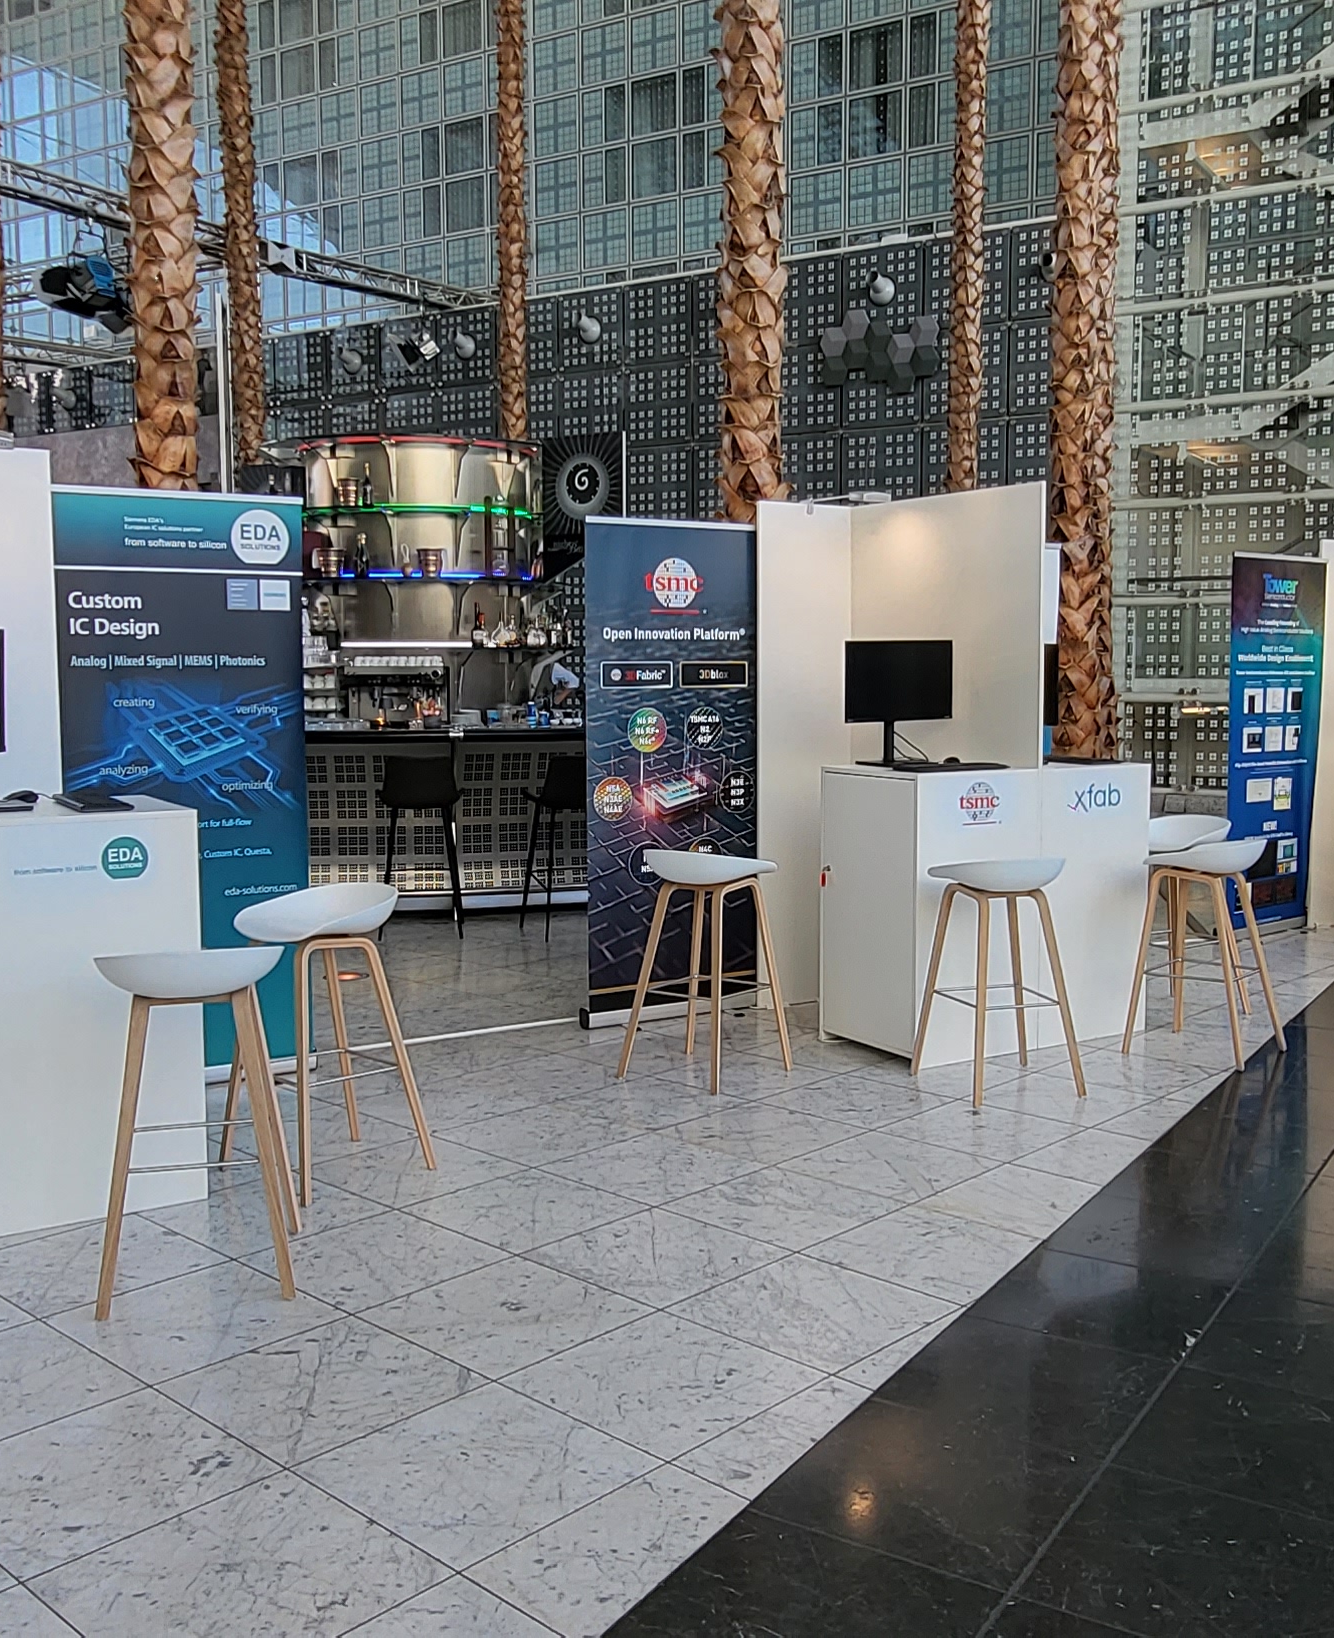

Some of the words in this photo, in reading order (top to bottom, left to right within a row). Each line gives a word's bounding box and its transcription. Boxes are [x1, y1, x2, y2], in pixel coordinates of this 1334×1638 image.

[239, 524, 281, 542] EDA
[124, 537, 146, 547] from
[147, 538, 186, 549] software
[188, 540, 198, 549] to
[199, 540, 227, 550] silicon
[240, 543, 281, 551] SOLUTIONS
[644, 573, 704, 593] tsmc
[1263, 573, 1299, 594] Tower
[67, 591, 142, 609] Custom
[69, 618, 90, 635] IC
[94, 618, 160, 640] Design
[602, 627, 632, 642] Open
[634, 627, 691, 641] Innovation
[70, 655, 107, 669] Analog
[114, 655, 144, 667] Mixed
[146, 655, 177, 669] Signal
[184, 655, 213, 667] MEMS
[219, 655, 266, 667] Photonics
[699, 669, 729, 680] 3Dblox
[113, 697, 155, 709] creating
[235, 704, 278, 716] verifying
[99, 765, 149, 776] analyzing
[222, 780, 273, 791] optimizing
[959, 794, 1000, 811] tsmc
[107, 847, 144, 863] EDA
[203, 850, 233, 858] Custom
[108, 862, 143, 870] SOLUTIONS
[224, 884, 298, 897] eda-solutions.com
